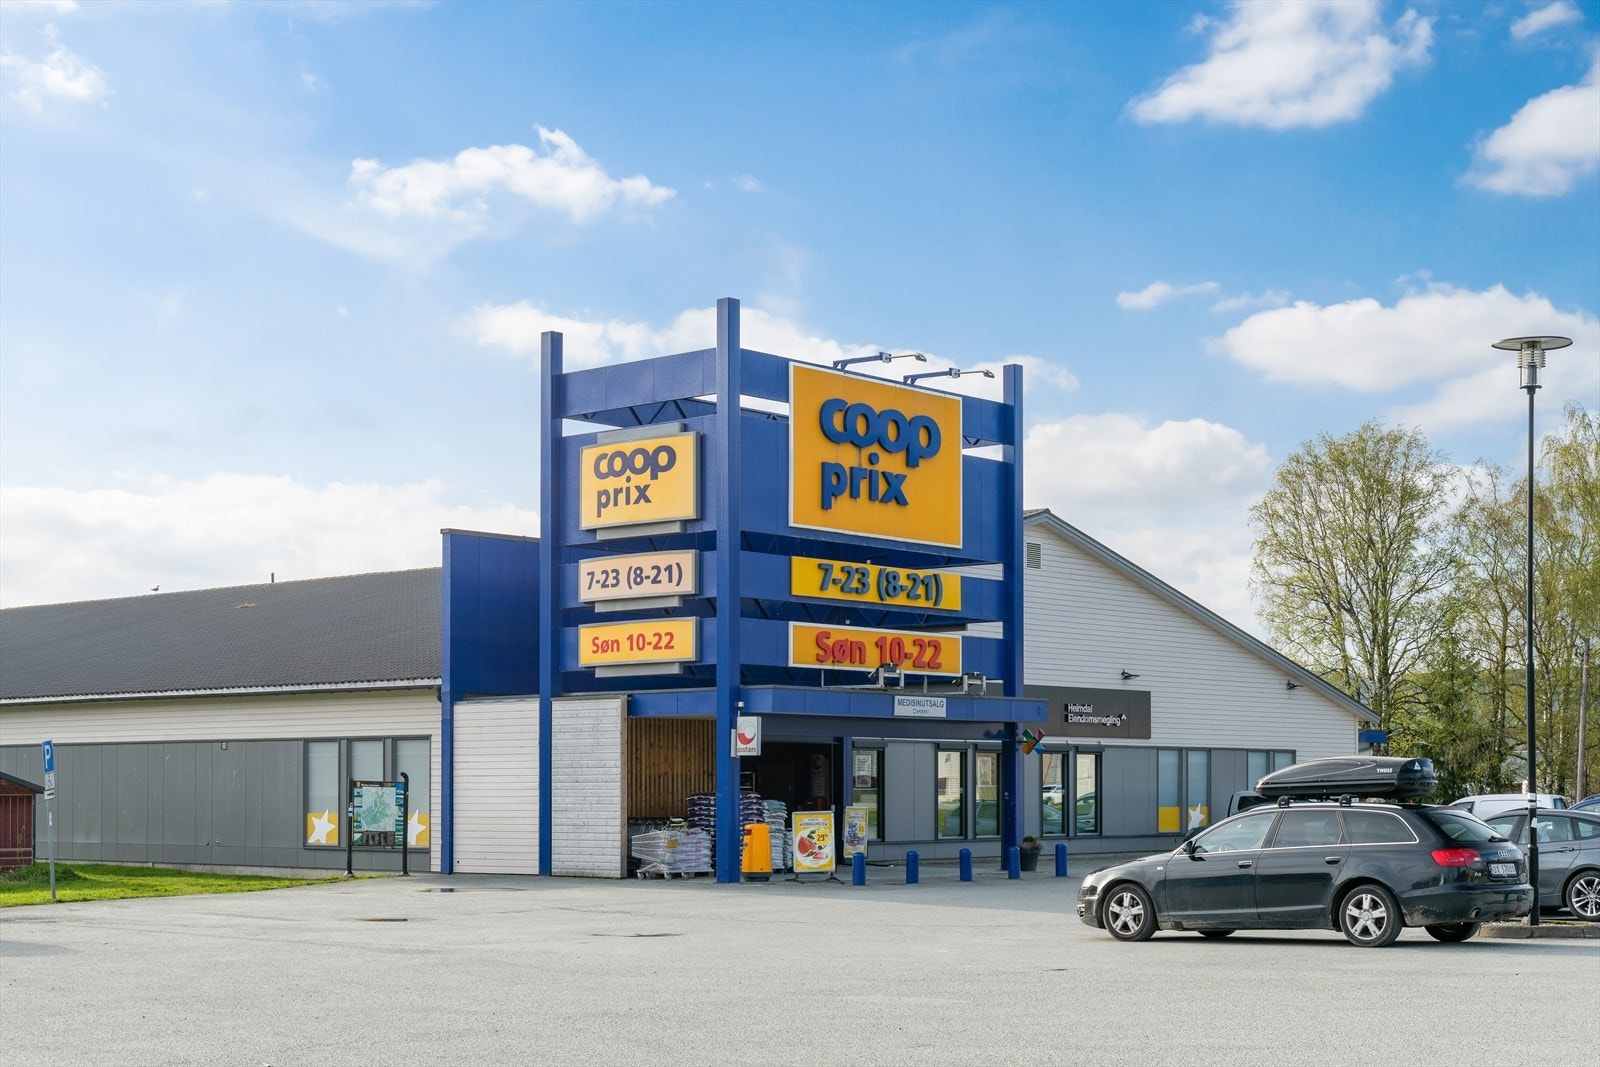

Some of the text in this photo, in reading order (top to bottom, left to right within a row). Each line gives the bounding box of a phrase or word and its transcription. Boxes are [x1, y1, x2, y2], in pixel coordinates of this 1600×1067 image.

[819, 398, 941, 468] coop
[593, 444, 677, 480] coop
[596, 476, 652, 518] prix
[821, 452, 909, 510] prix
[586, 562, 683, 590] 7-23 (8-21)
[817, 563, 943, 606] 7-23 (8-21)
[591, 632, 675, 654] Søn 10-22
[815, 631, 943, 670] Søn 10-22
[897, 698, 945, 708] MEDISINUTSALG
[1068, 703, 1093, 713] Heimdal
[1068, 714, 1121, 727] Eiendomsmegling
[44, 744, 52, 770] P
